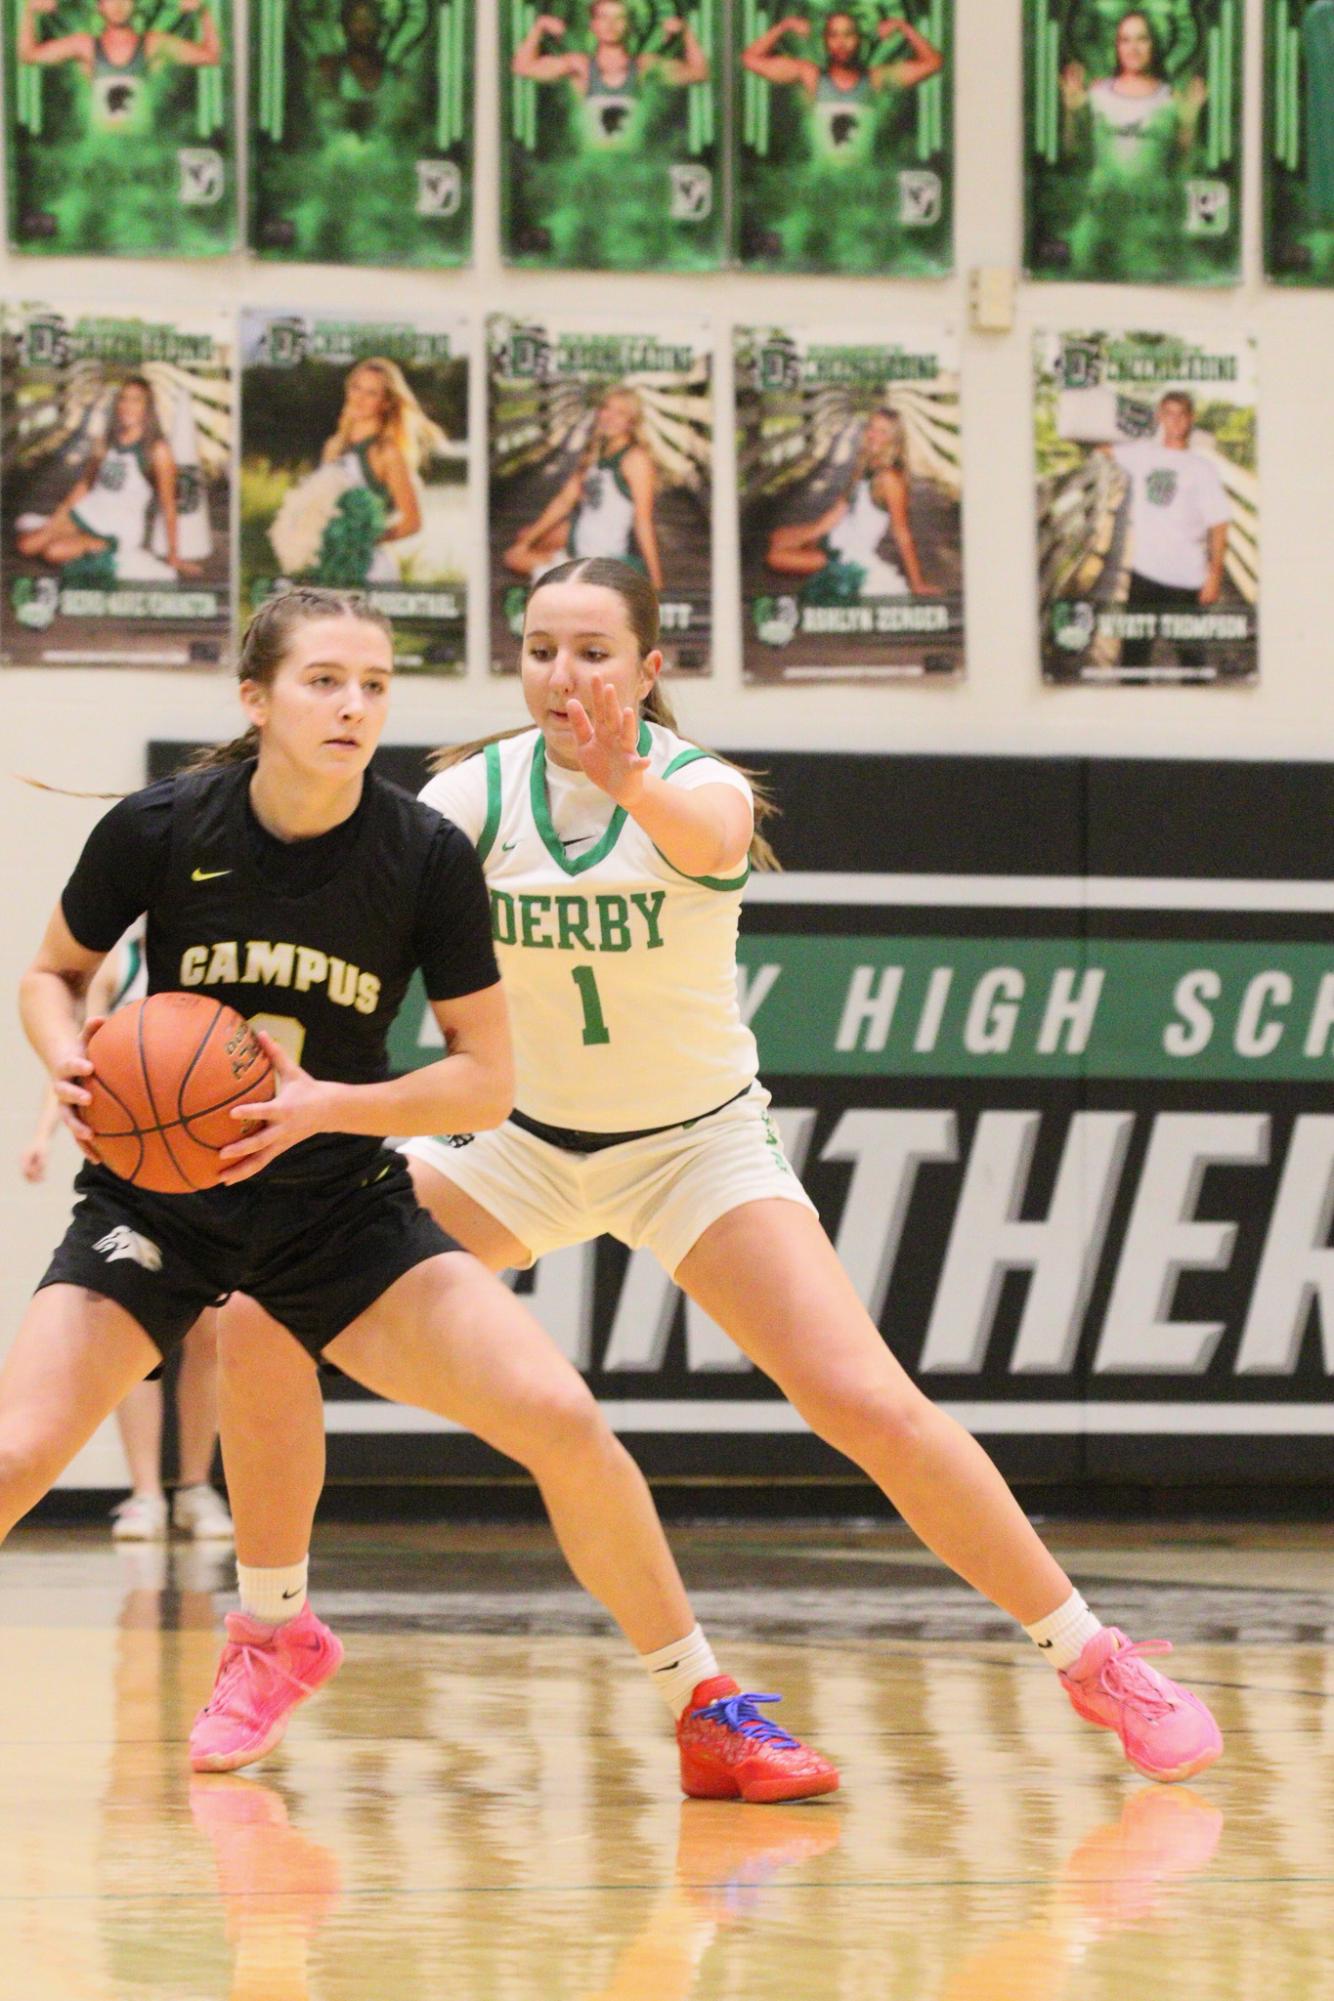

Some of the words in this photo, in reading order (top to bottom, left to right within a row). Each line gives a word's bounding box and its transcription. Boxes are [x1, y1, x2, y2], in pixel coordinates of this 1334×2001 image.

[490, 888, 666, 952] DERBY
[180, 940, 381, 1015] CAMPUS
[571, 965, 610, 1046] 1
[834, 963, 1105, 1056] HIGH
[512, 1109, 1334, 1374] THER
